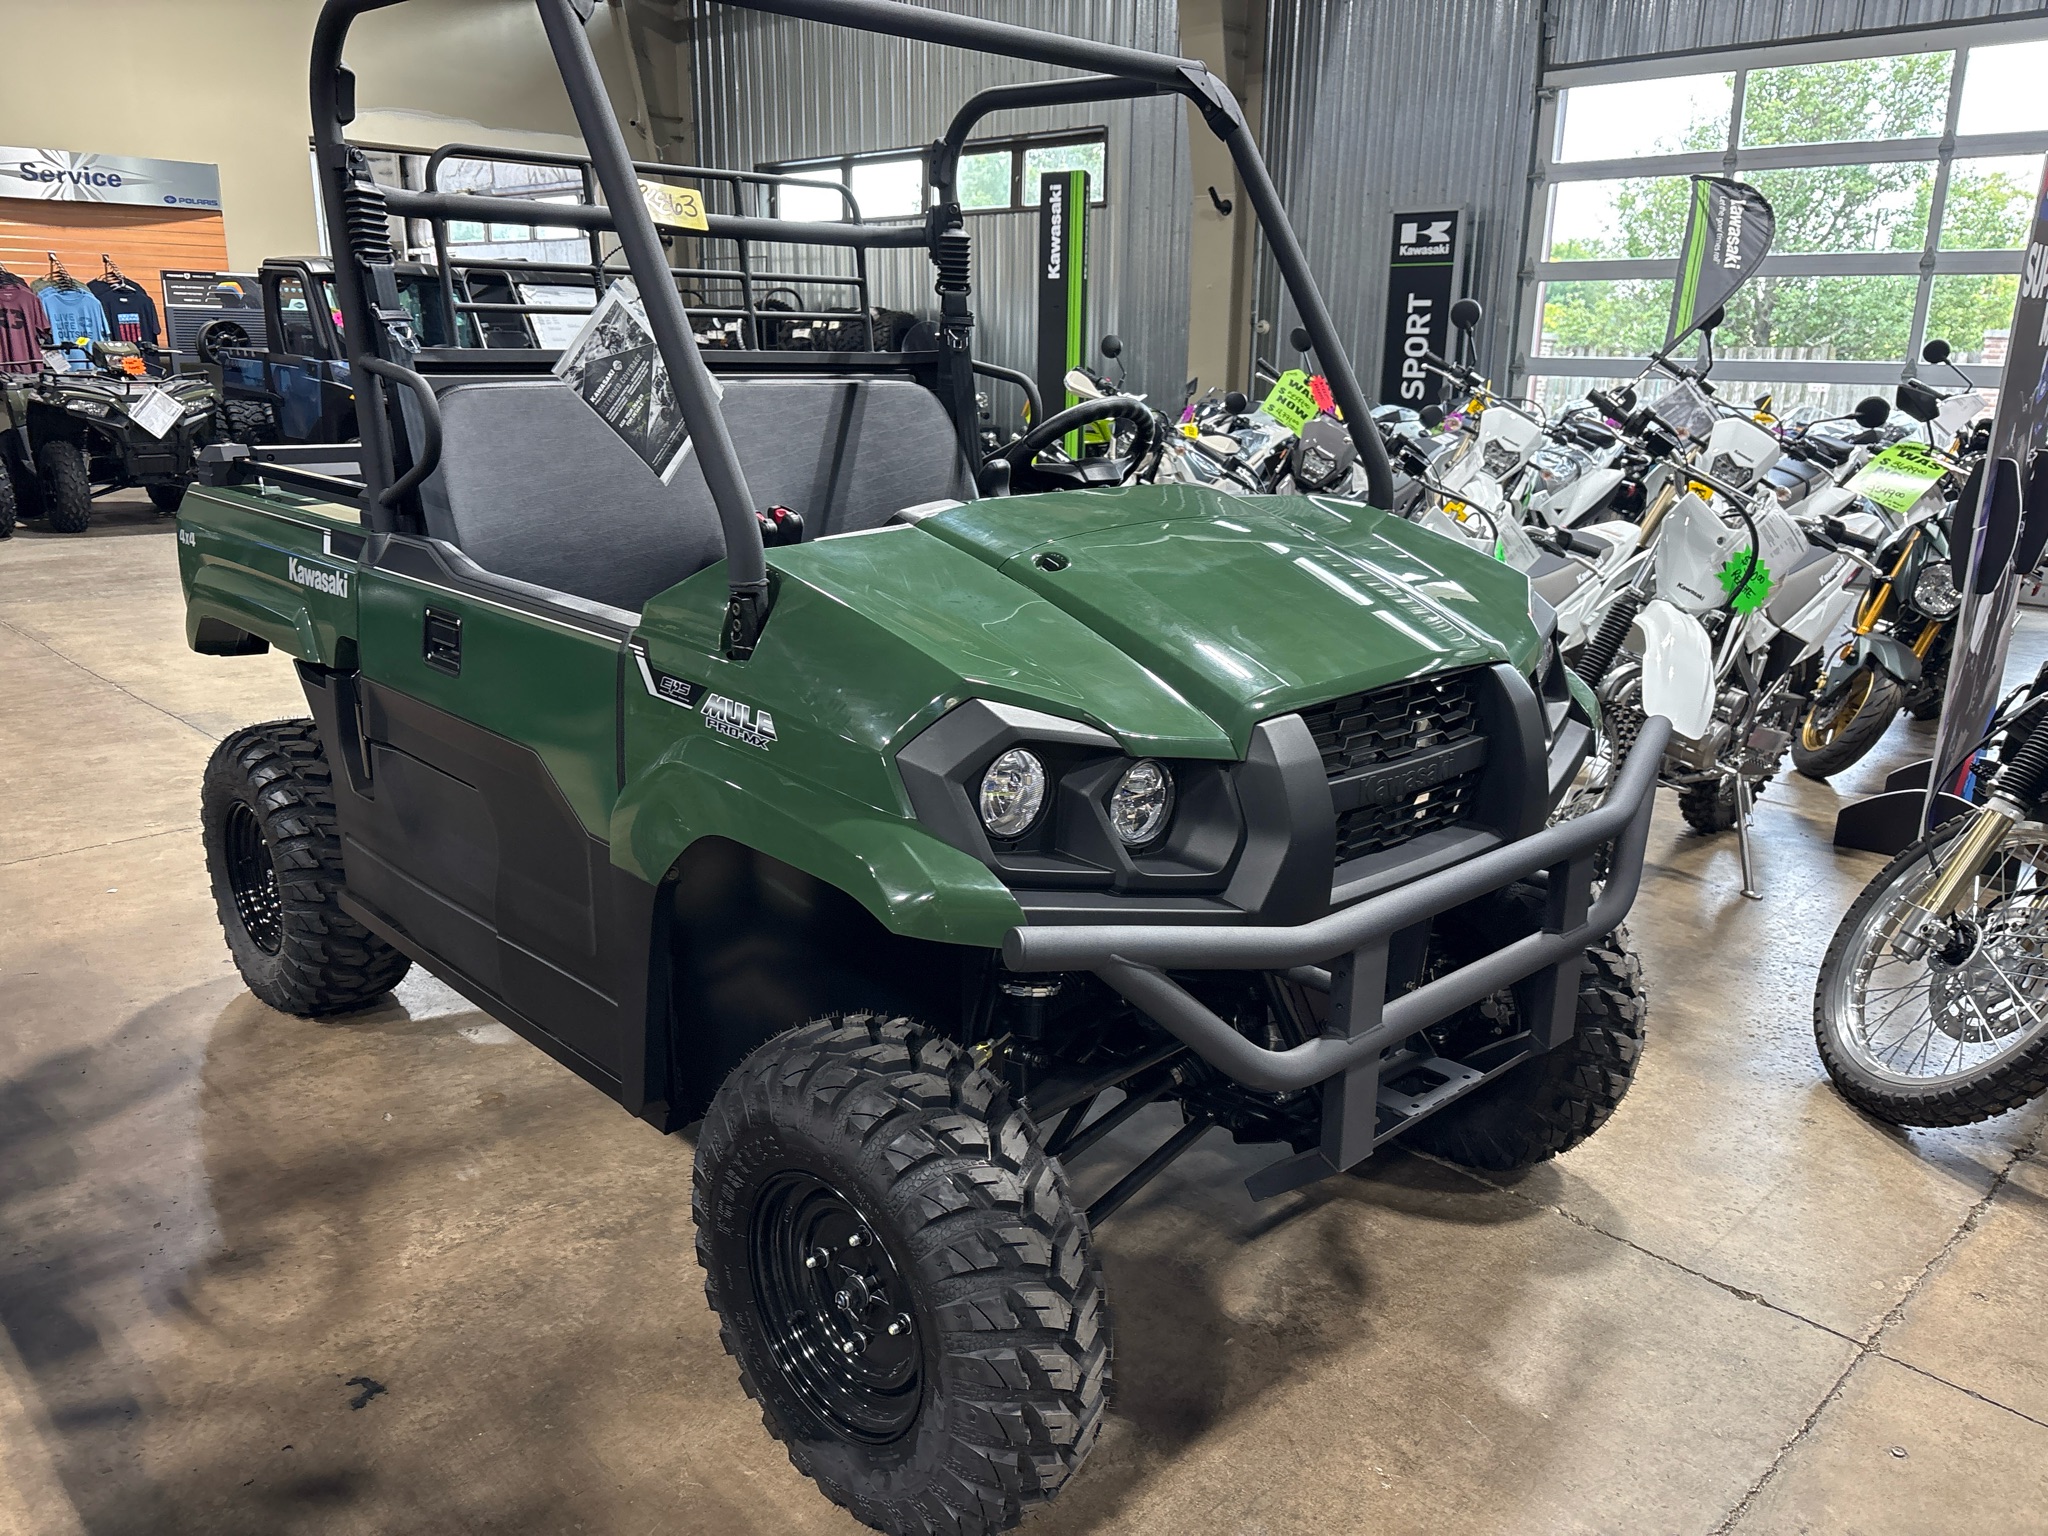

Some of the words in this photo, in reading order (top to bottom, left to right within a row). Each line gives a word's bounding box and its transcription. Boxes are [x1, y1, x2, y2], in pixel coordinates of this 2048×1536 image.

[20, 162, 122, 188] Service
[178, 197, 218, 207] POLARIS
[1047, 184, 1062, 279] Kawasaki
[1399, 244, 1450, 256] Kawasaki
[54, 313, 75, 322] LIVE
[56, 321, 77, 330] LIFE
[1401, 292, 1433, 400] SPORT
[620, 352, 643, 384] COVERAGE
[589, 368, 616, 403] KAWASAKI
[1276, 395, 1308, 420] NOW
[1897, 449, 1941, 471] WAS
[179, 528, 196, 547] 4x4
[288, 556, 348, 598] Kawasaki
[660, 676, 691, 696] EPS
[700, 692, 778, 741] MULE
[705, 716, 770, 751] PRO-MX
